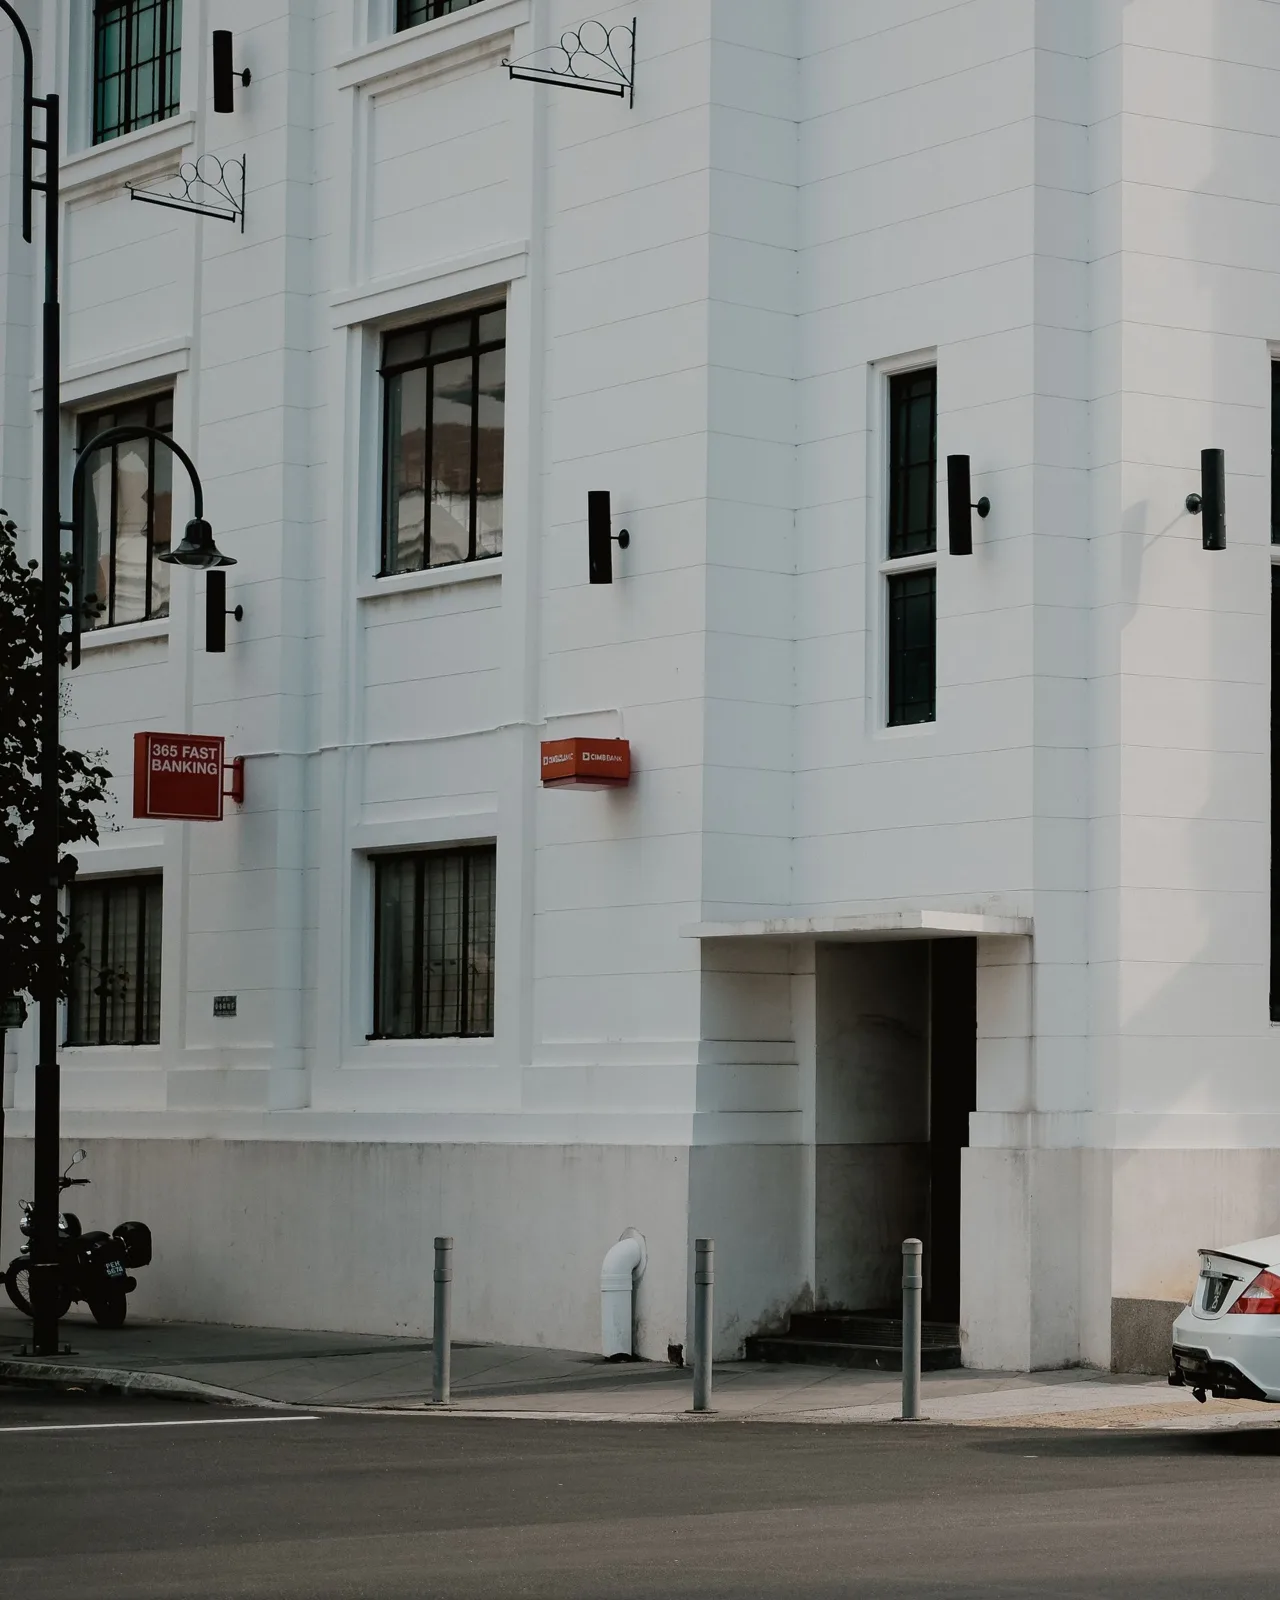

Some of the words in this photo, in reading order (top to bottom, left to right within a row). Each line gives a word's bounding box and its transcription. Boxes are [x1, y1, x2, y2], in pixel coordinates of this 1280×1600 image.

[152, 744, 178, 757] 365
[182, 745, 218, 760] FAST
[590, 753, 606, 761] CIMB
[606, 754, 623, 762] BANK
[151, 759, 218, 775] BANKING
